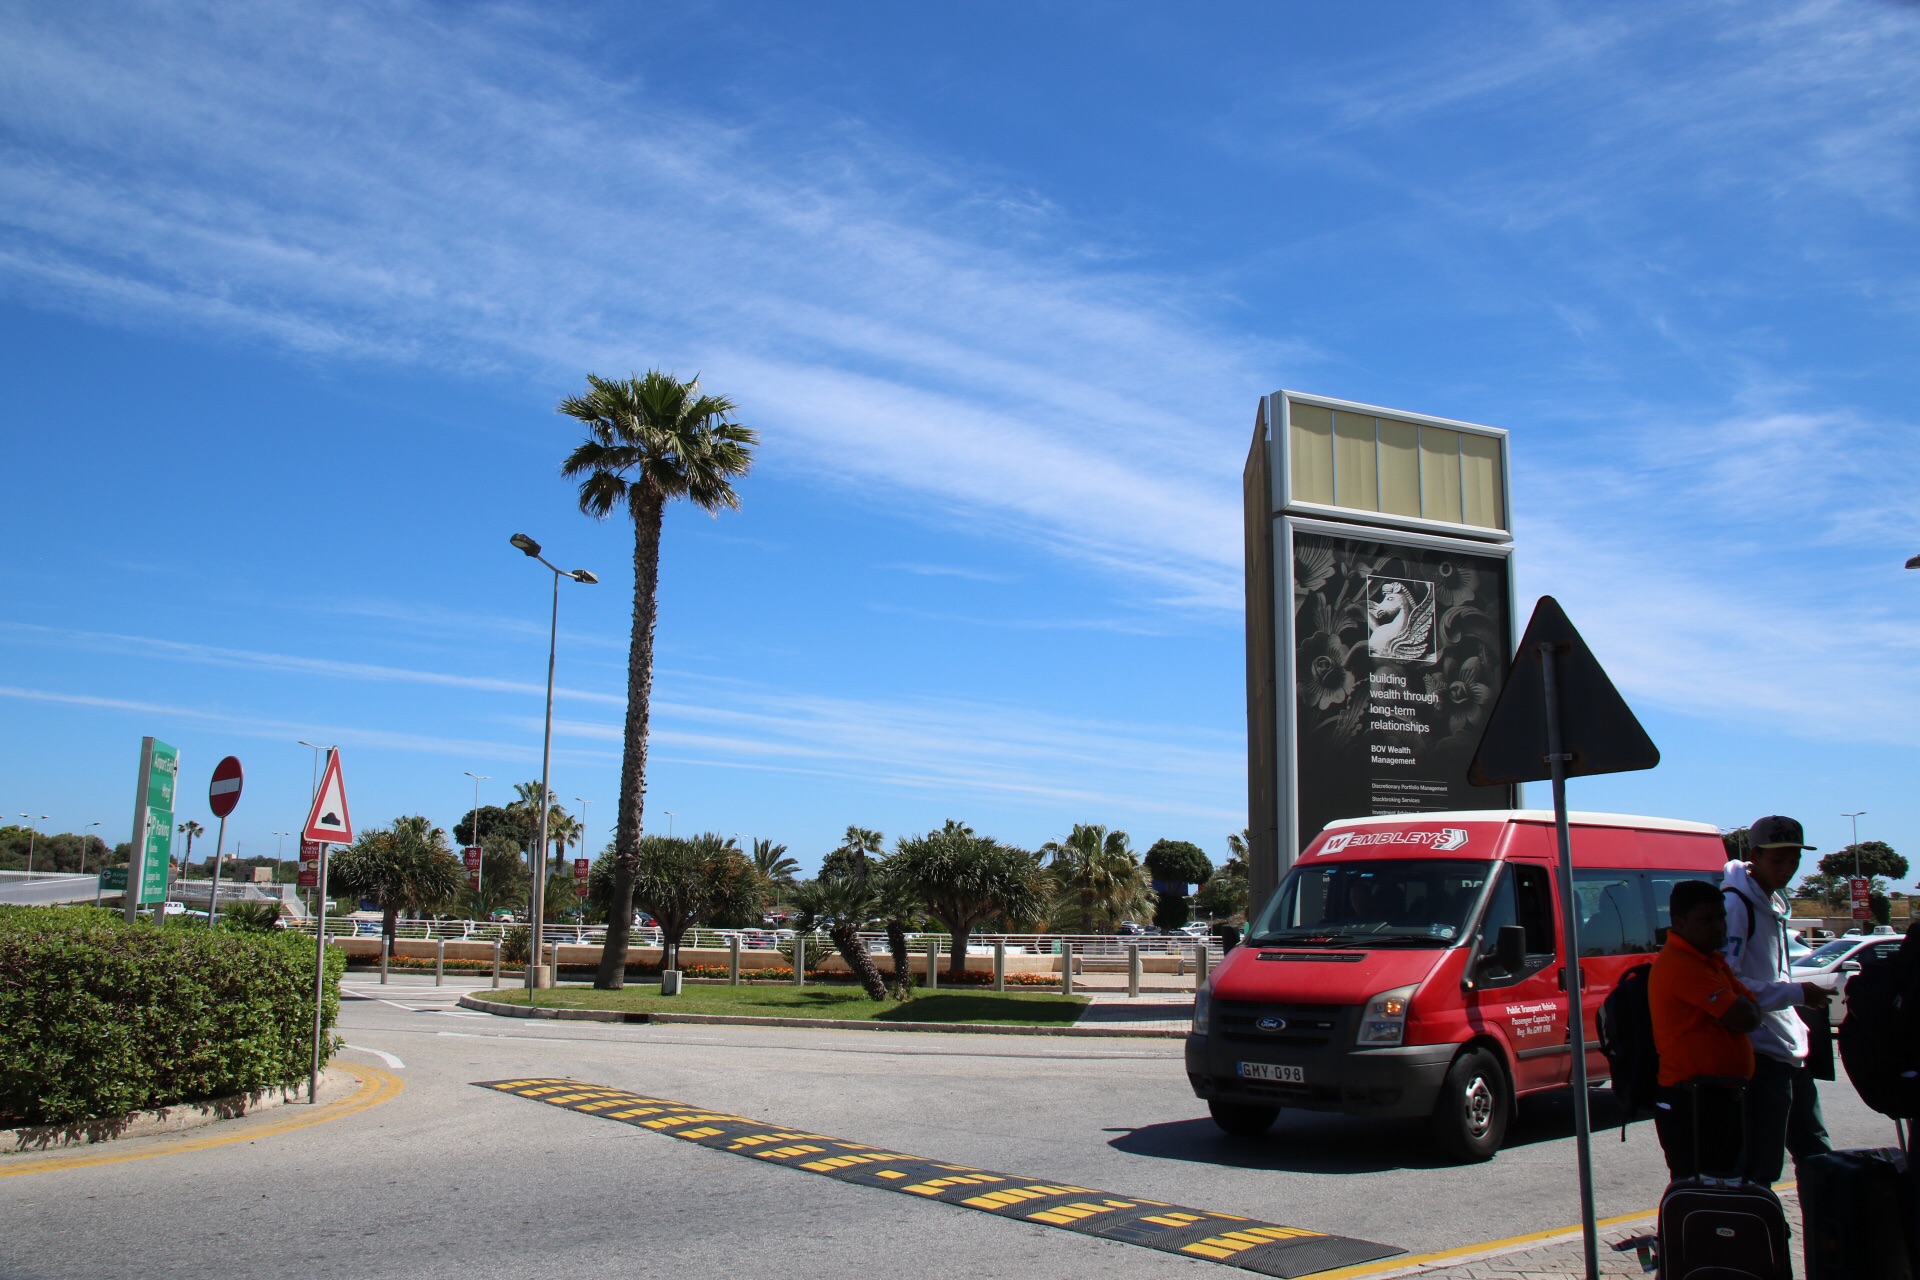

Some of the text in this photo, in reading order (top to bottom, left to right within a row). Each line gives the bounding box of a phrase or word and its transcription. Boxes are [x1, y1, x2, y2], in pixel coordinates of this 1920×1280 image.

[1369, 672, 1407, 687] building
[1369, 689, 1439, 704] wealth through
[1369, 703, 1416, 717] long-term
[1370, 719, 1430, 734] relationships
[1371, 744, 1411, 754] BOV Wealth
[1371, 755, 1416, 766] Management
[1371, 782, 1401, 790] Discretionary
[1371, 796, 1401, 804] Stockbroking
[1325, 831, 1452, 850] WEMBLEYS
[1506, 1002, 1557, 1014] Public Transport Vehicle
[1512, 1018, 1532, 1026] Passenger
[1243, 1063, 1301, 1081] GMY 098
